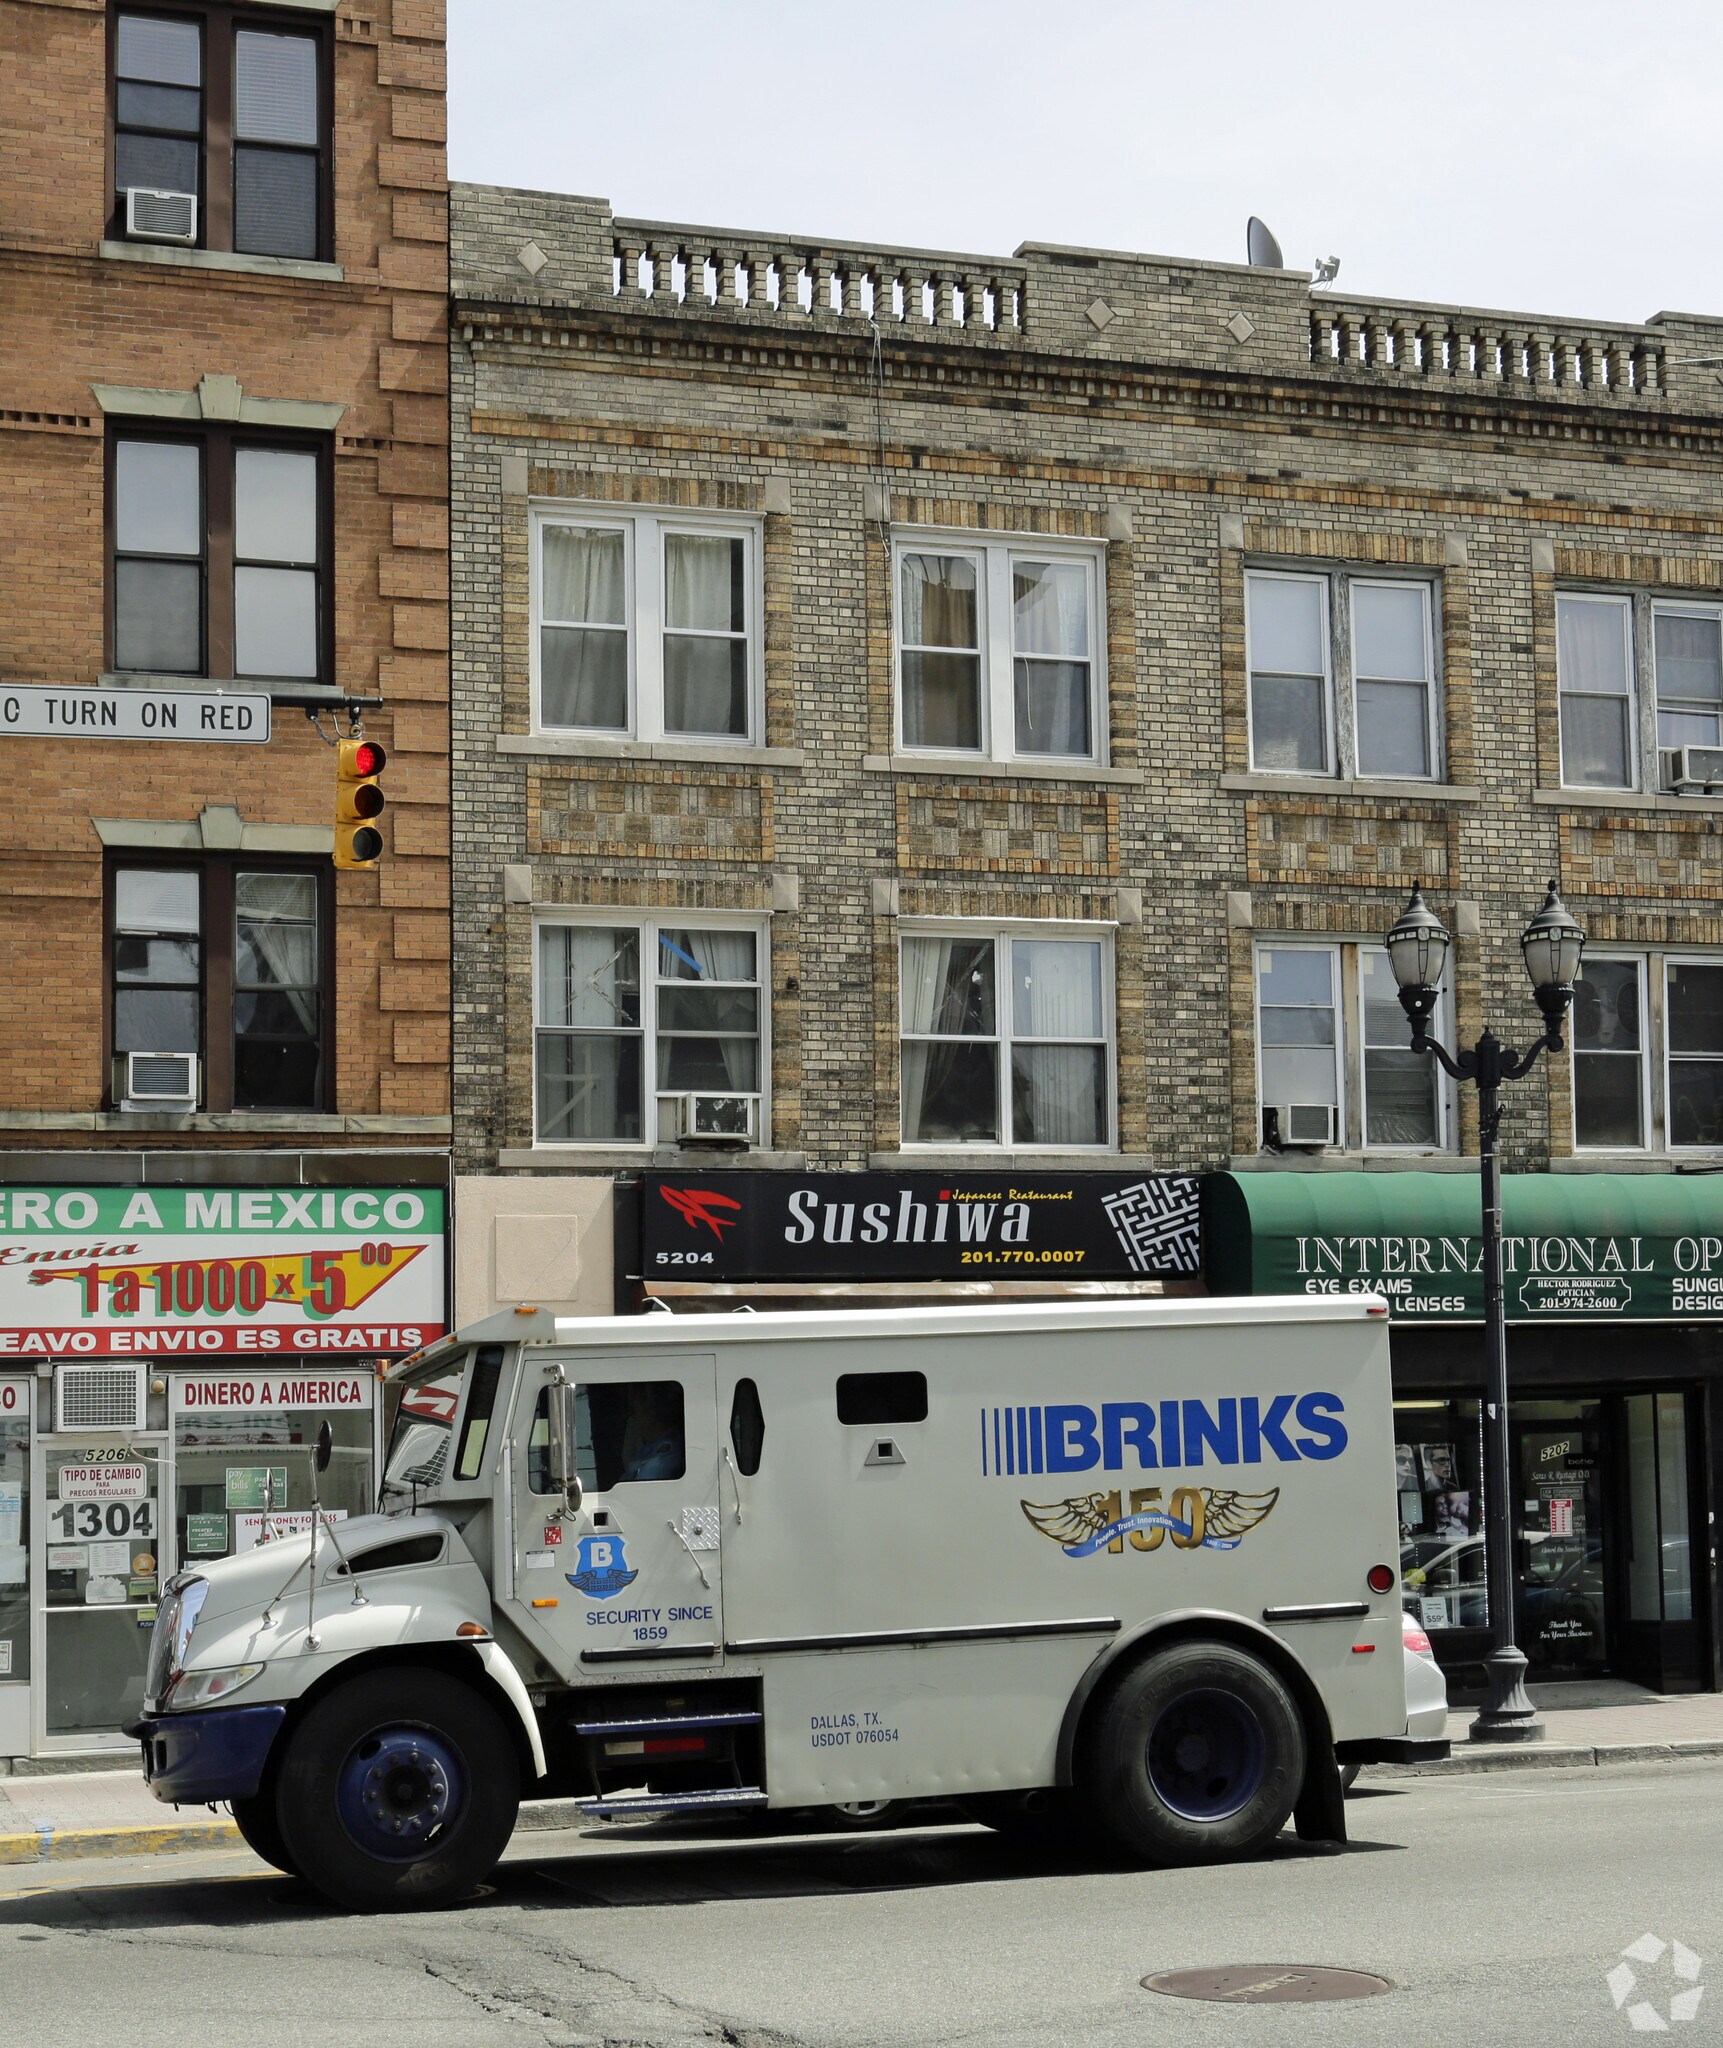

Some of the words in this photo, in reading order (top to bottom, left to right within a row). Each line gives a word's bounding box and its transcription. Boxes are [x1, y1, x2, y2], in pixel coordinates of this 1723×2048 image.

[44, 699, 117, 726] TURN
[141, 702, 177, 728] ON
[200, 704, 253, 731] RED
[952, 1188, 1002, 1203] Japanese
[0, 1192, 99, 1229] RO
[120, 1192, 162, 1229] A
[185, 1192, 425, 1230] MEXICO
[785, 1190, 1031, 1244] Sushiwa
[0, 1241, 143, 1266] Envia
[655, 1252, 714, 1265] 5204
[960, 1250, 1085, 1263] 201.770.0007
[1673, 1236, 1723, 1272] OP
[150, 1260, 267, 1316] 1000
[273, 1273, 297, 1298] x
[1304, 1278, 1340, 1295] EYE
[1347, 1278, 1413, 1295] EXAMS
[1537, 1279, 1570, 1288] HECTOR
[1571, 1279, 1617, 1288] RODRIGUEZ
[1557, 1288, 1595, 1297] OPTICIAN
[1395, 1296, 1465, 1312] LENSES
[1539, 1297, 1617, 1309] 201-974-2600
[110, 1329, 224, 1351] ENVIO
[236, 1328, 281, 1350] ES
[292, 1327, 423, 1349] GRATIS
[185, 1381, 254, 1406] DINERO
[262, 1382, 276, 1405] A
[278, 1380, 362, 1405] AMERICA
[1044, 1391, 1349, 1474] BRINKS
[85, 1448, 126, 1462] 5206
[1541, 1441, 1569, 1460] 5202
[64, 1469, 87, 1482] TIPO
[89, 1469, 103, 1481] DE
[104, 1467, 141, 1481] CAMBIO
[228, 1470, 243, 1480] pay
[231, 1478, 249, 1490] bills
[69, 1489, 97, 1497] PRECIOS
[98, 1488, 137, 1497] REGULARES
[51, 1502, 153, 1538] 1304
[1096, 1486, 1206, 1554] 150
[1117, 1519, 1136, 1532] Trust.
[1137, 1516, 1175, 1528] Innovation.
[590, 1541, 614, 1568] B
[586, 1608, 661, 1626] SECURITY
[668, 1605, 713, 1622] SINCE
[632, 1625, 668, 1641] 1859
[810, 1712, 858, 1730] DALLAS,
[863, 1711, 883, 1727] TX.
[811, 1731, 852, 1748] USDOT
[855, 1728, 900, 1745] 076054
